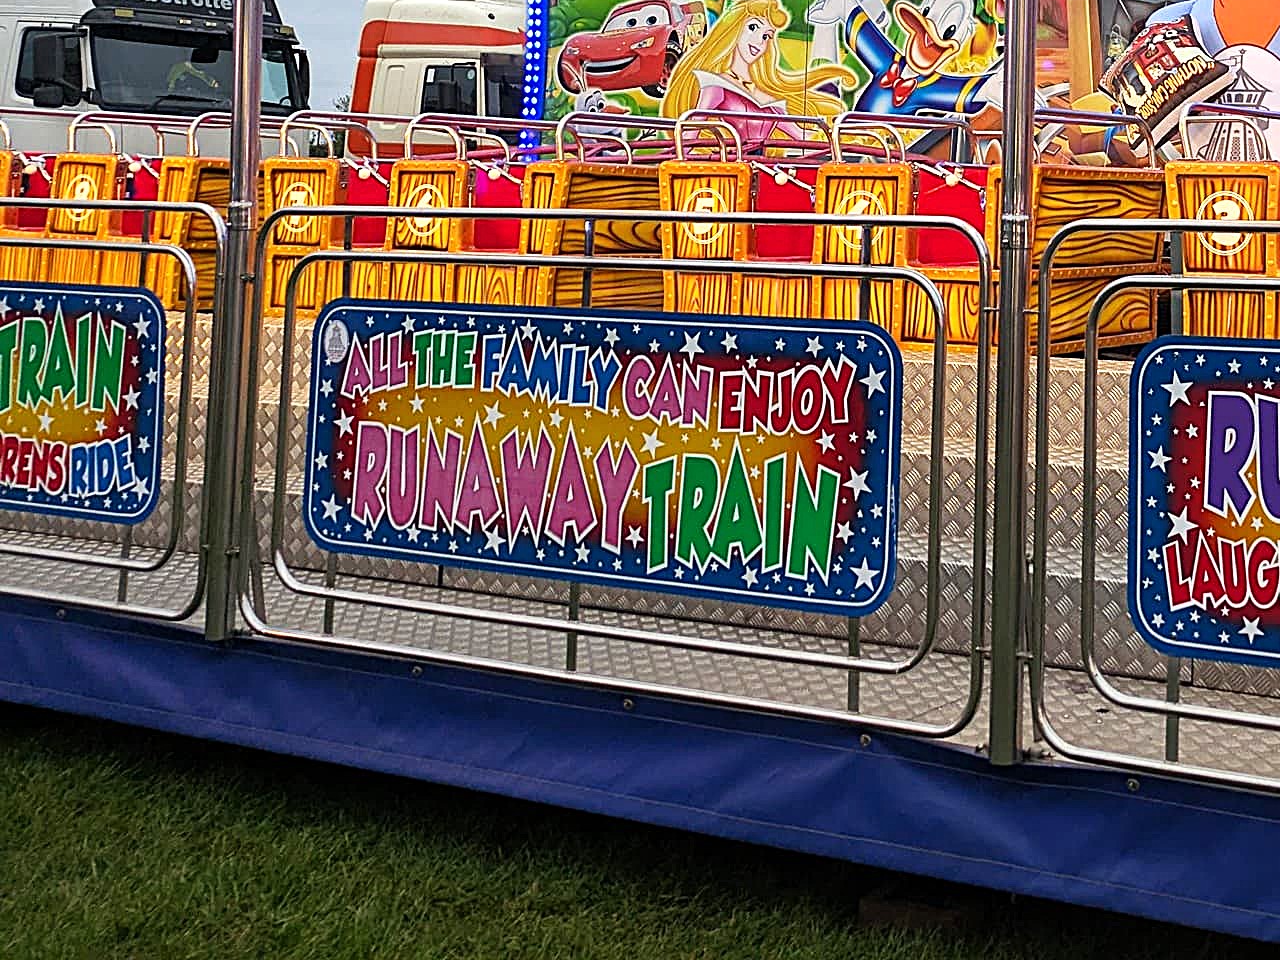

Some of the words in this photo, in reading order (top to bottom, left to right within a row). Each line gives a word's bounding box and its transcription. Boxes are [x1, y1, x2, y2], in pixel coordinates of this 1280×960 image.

[340, 328, 412, 400] ALL
[411, 329, 479, 389] THE
[480, 327, 622, 411] FAMILY
[621, 354, 714, 425] CAN
[717, 354, 856, 436] ENJOY
[68, 433, 136, 498] RIDE
[350, 411, 639, 554] RUNAWAY
[642, 436, 840, 584] TRAIN
